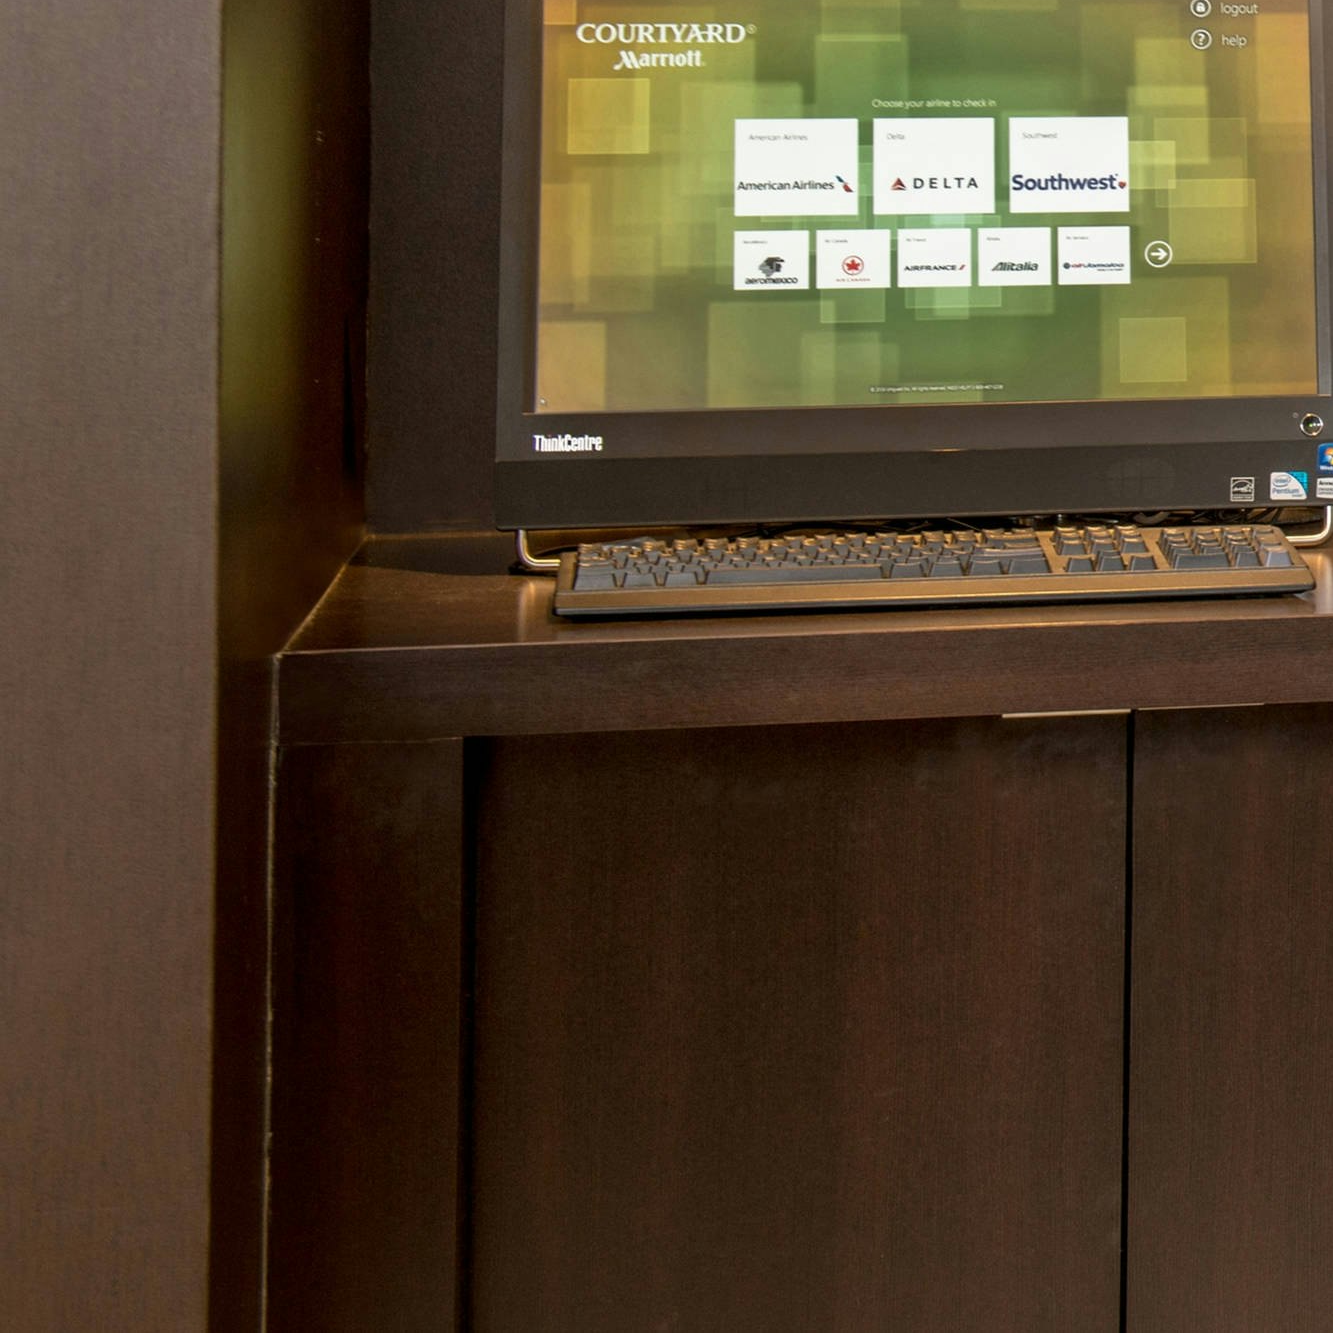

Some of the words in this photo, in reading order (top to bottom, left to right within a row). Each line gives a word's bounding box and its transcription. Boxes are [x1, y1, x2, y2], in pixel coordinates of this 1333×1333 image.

[1220, 2, 1259, 17] logout
[576, 23, 746, 44] COURTYARD
[1221, 34, 1248, 49] help
[613, 50, 704, 71] Marriott
[872, 98, 904, 108] Choose
[905, 100, 924, 109] your
[925, 98, 951, 108] airline
[952, 99, 962, 107] to
[963, 98, 987, 107] check
[988, 97, 997, 106] in
[737, 180, 791, 191] American
[792, 180, 835, 190] Airlines
[912, 177, 979, 190] DELTA
[1011, 174, 1118, 191] Southwest
[992, 261, 1039, 272] Alitalia
[533, 434, 603, 453] ThinkCentre
